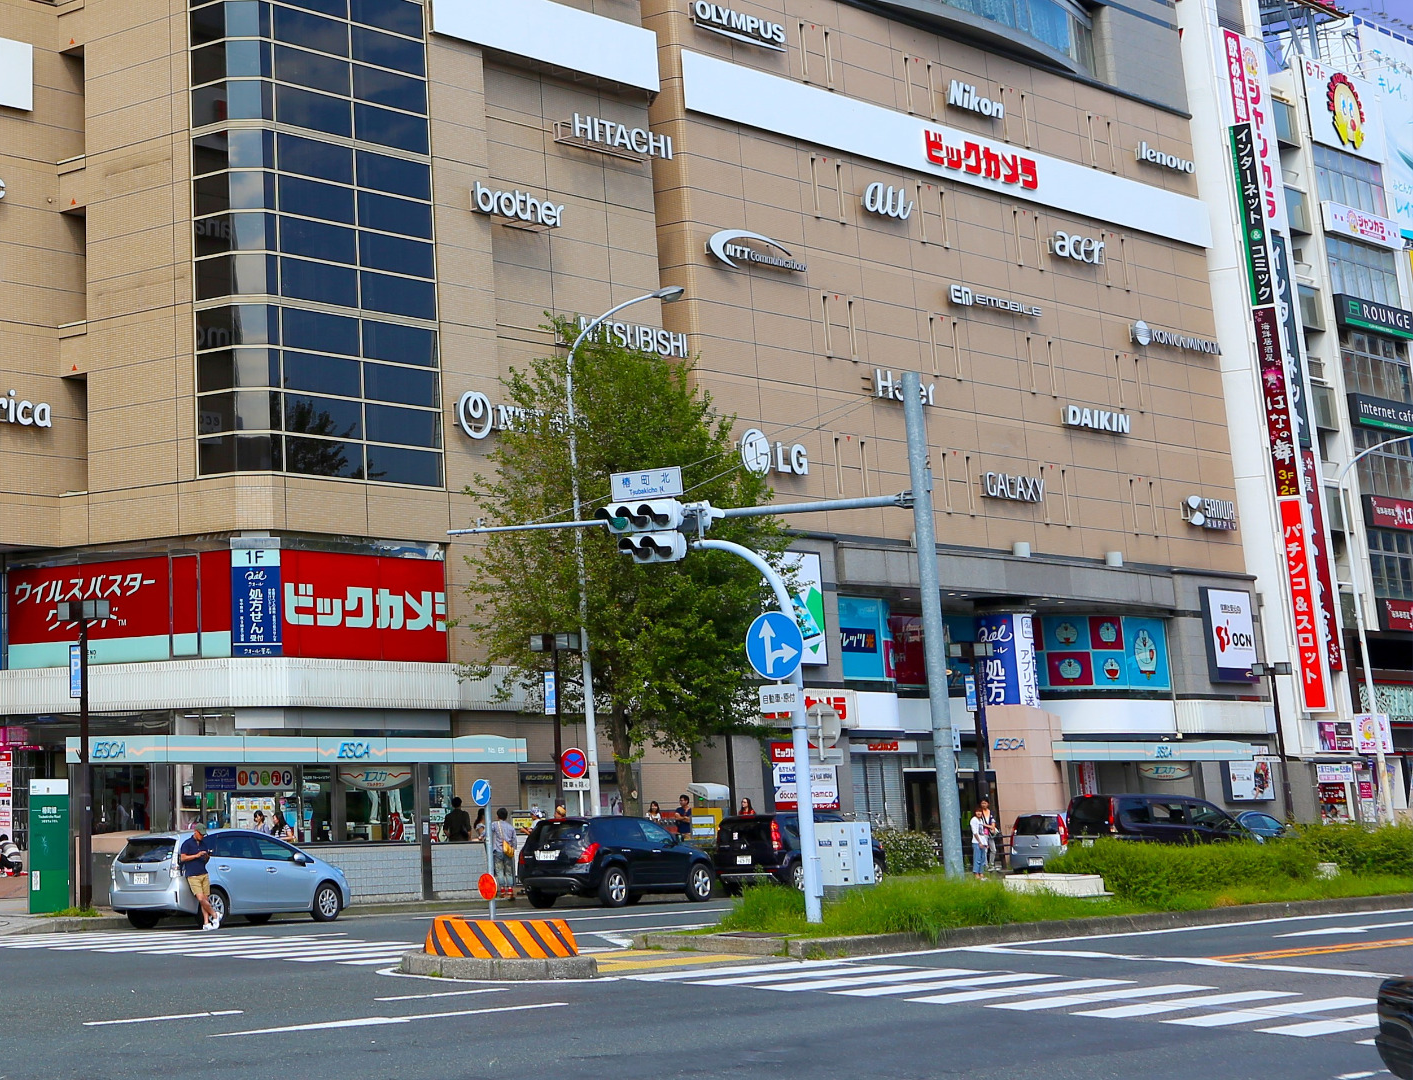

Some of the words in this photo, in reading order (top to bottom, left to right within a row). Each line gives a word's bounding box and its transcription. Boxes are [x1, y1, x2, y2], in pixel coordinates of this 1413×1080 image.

[694, 1, 786, 43] OLYMPUS
[947, 79, 1005, 120] Nikon
[572, 112, 674, 160] HITACHI
[924, 129, 1039, 190] ビックカメラ
[1139, 141, 1196, 175] lenovo
[472, 181, 565, 228] brother
[864, 181, 914, 221] au
[726, 243, 751, 259] NTT
[1053, 230, 1106, 265] acer
[975, 293, 1043, 317] EMOBILE
[1362, 303, 1411, 329] ROUNGE
[873, 368, 935, 406] Haer
[1066, 404, 1131, 435] DAIKIN
[1359, 401, 1397, 420] internet
[775, 440, 809, 475] LG
[986, 471, 1045, 504] GALAXY
[1204, 498, 1236, 520] SANWA
[1206, 519, 1238, 531] SUPPLY
[245, 550, 265, 564] 1F
[14, 572, 156, 605] ウイルスバスター
[248, 588, 264, 634] 処方せん
[840, 632, 875, 649] レッツ光
[1232, 632, 1253, 648] OCN
[966, 683, 975, 696] P
[92, 740, 128, 760] ESCA
[336, 741, 371, 760] ESCA
[993, 738, 1026, 751] ESCA
[211, 768, 230, 778] ESCA
[362, 770, 388, 782] エスカ
[1152, 765, 1176, 775] エスカ
